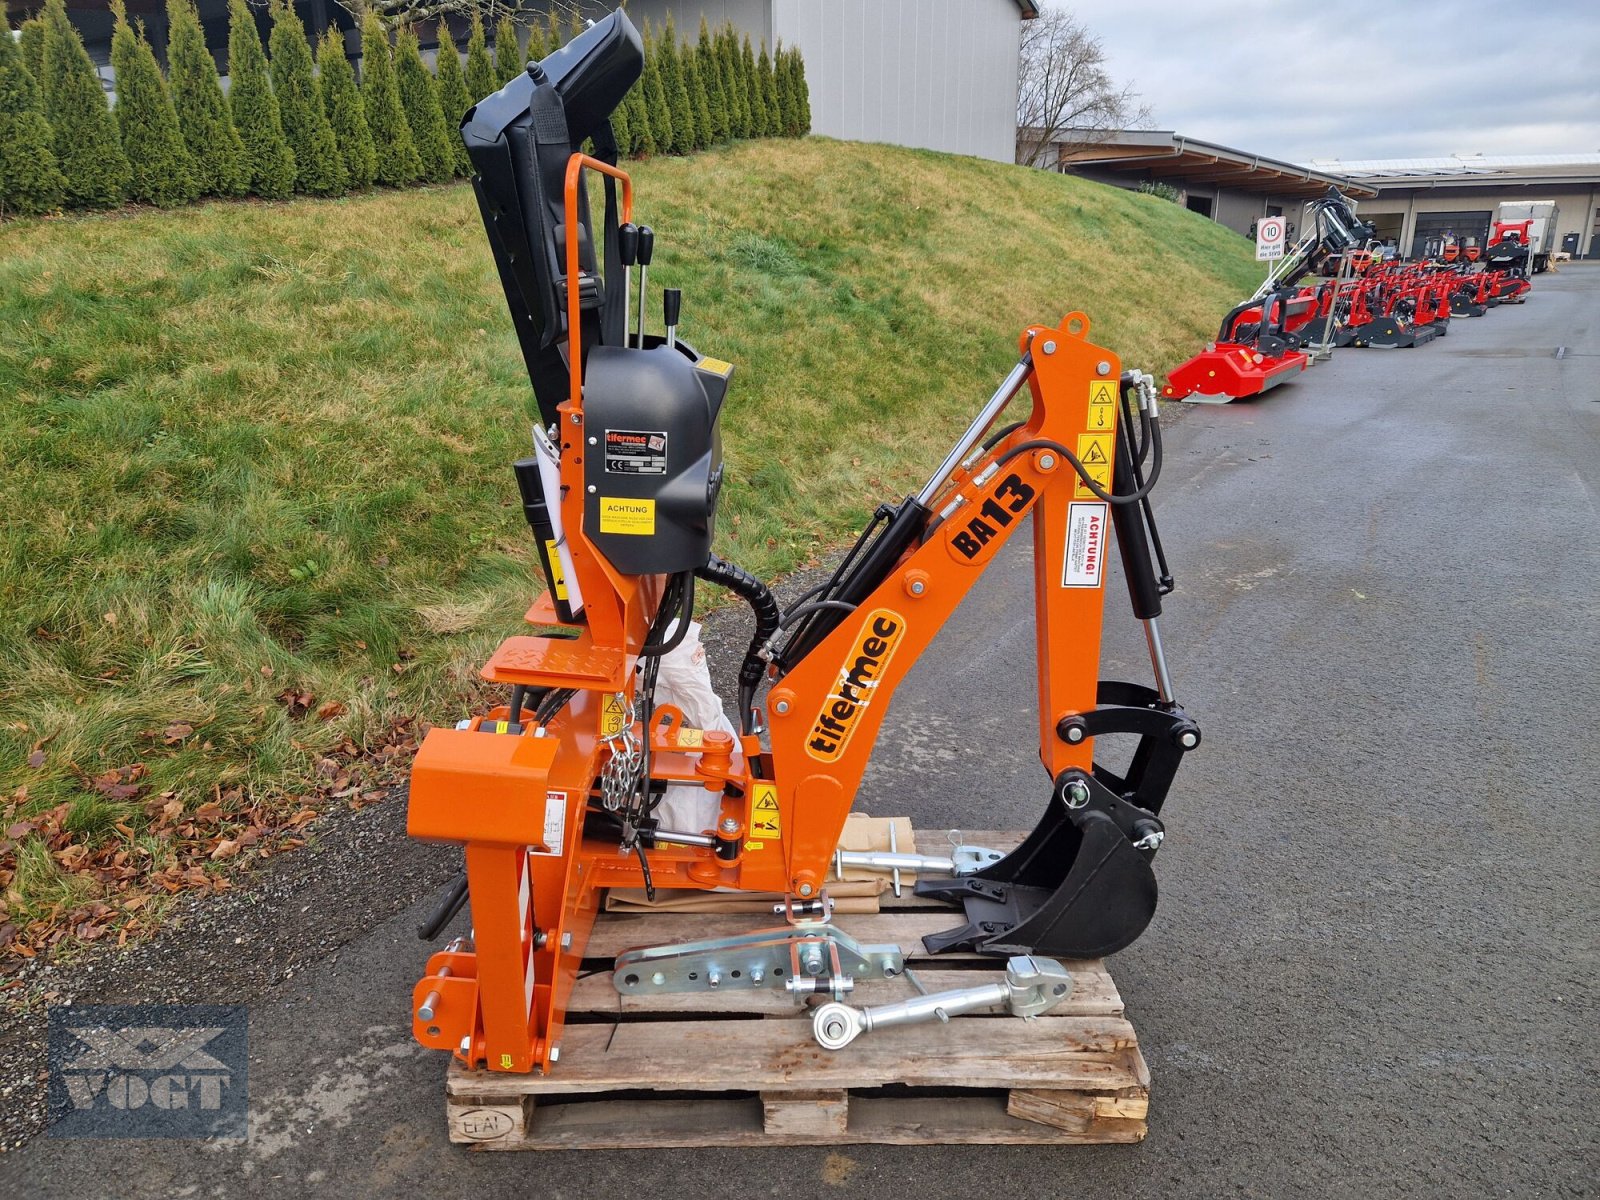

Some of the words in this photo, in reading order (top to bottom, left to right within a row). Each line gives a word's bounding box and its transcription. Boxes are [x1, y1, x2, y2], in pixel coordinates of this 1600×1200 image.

[1266, 226, 1277, 237] 10
[606, 433, 647, 443] tifermec
[607, 505, 648, 513] ACHTUNG
[951, 473, 1035, 560] BA13
[1085, 515, 1100, 575] ACHTUNG!
[809, 616, 897, 754] tifermec
